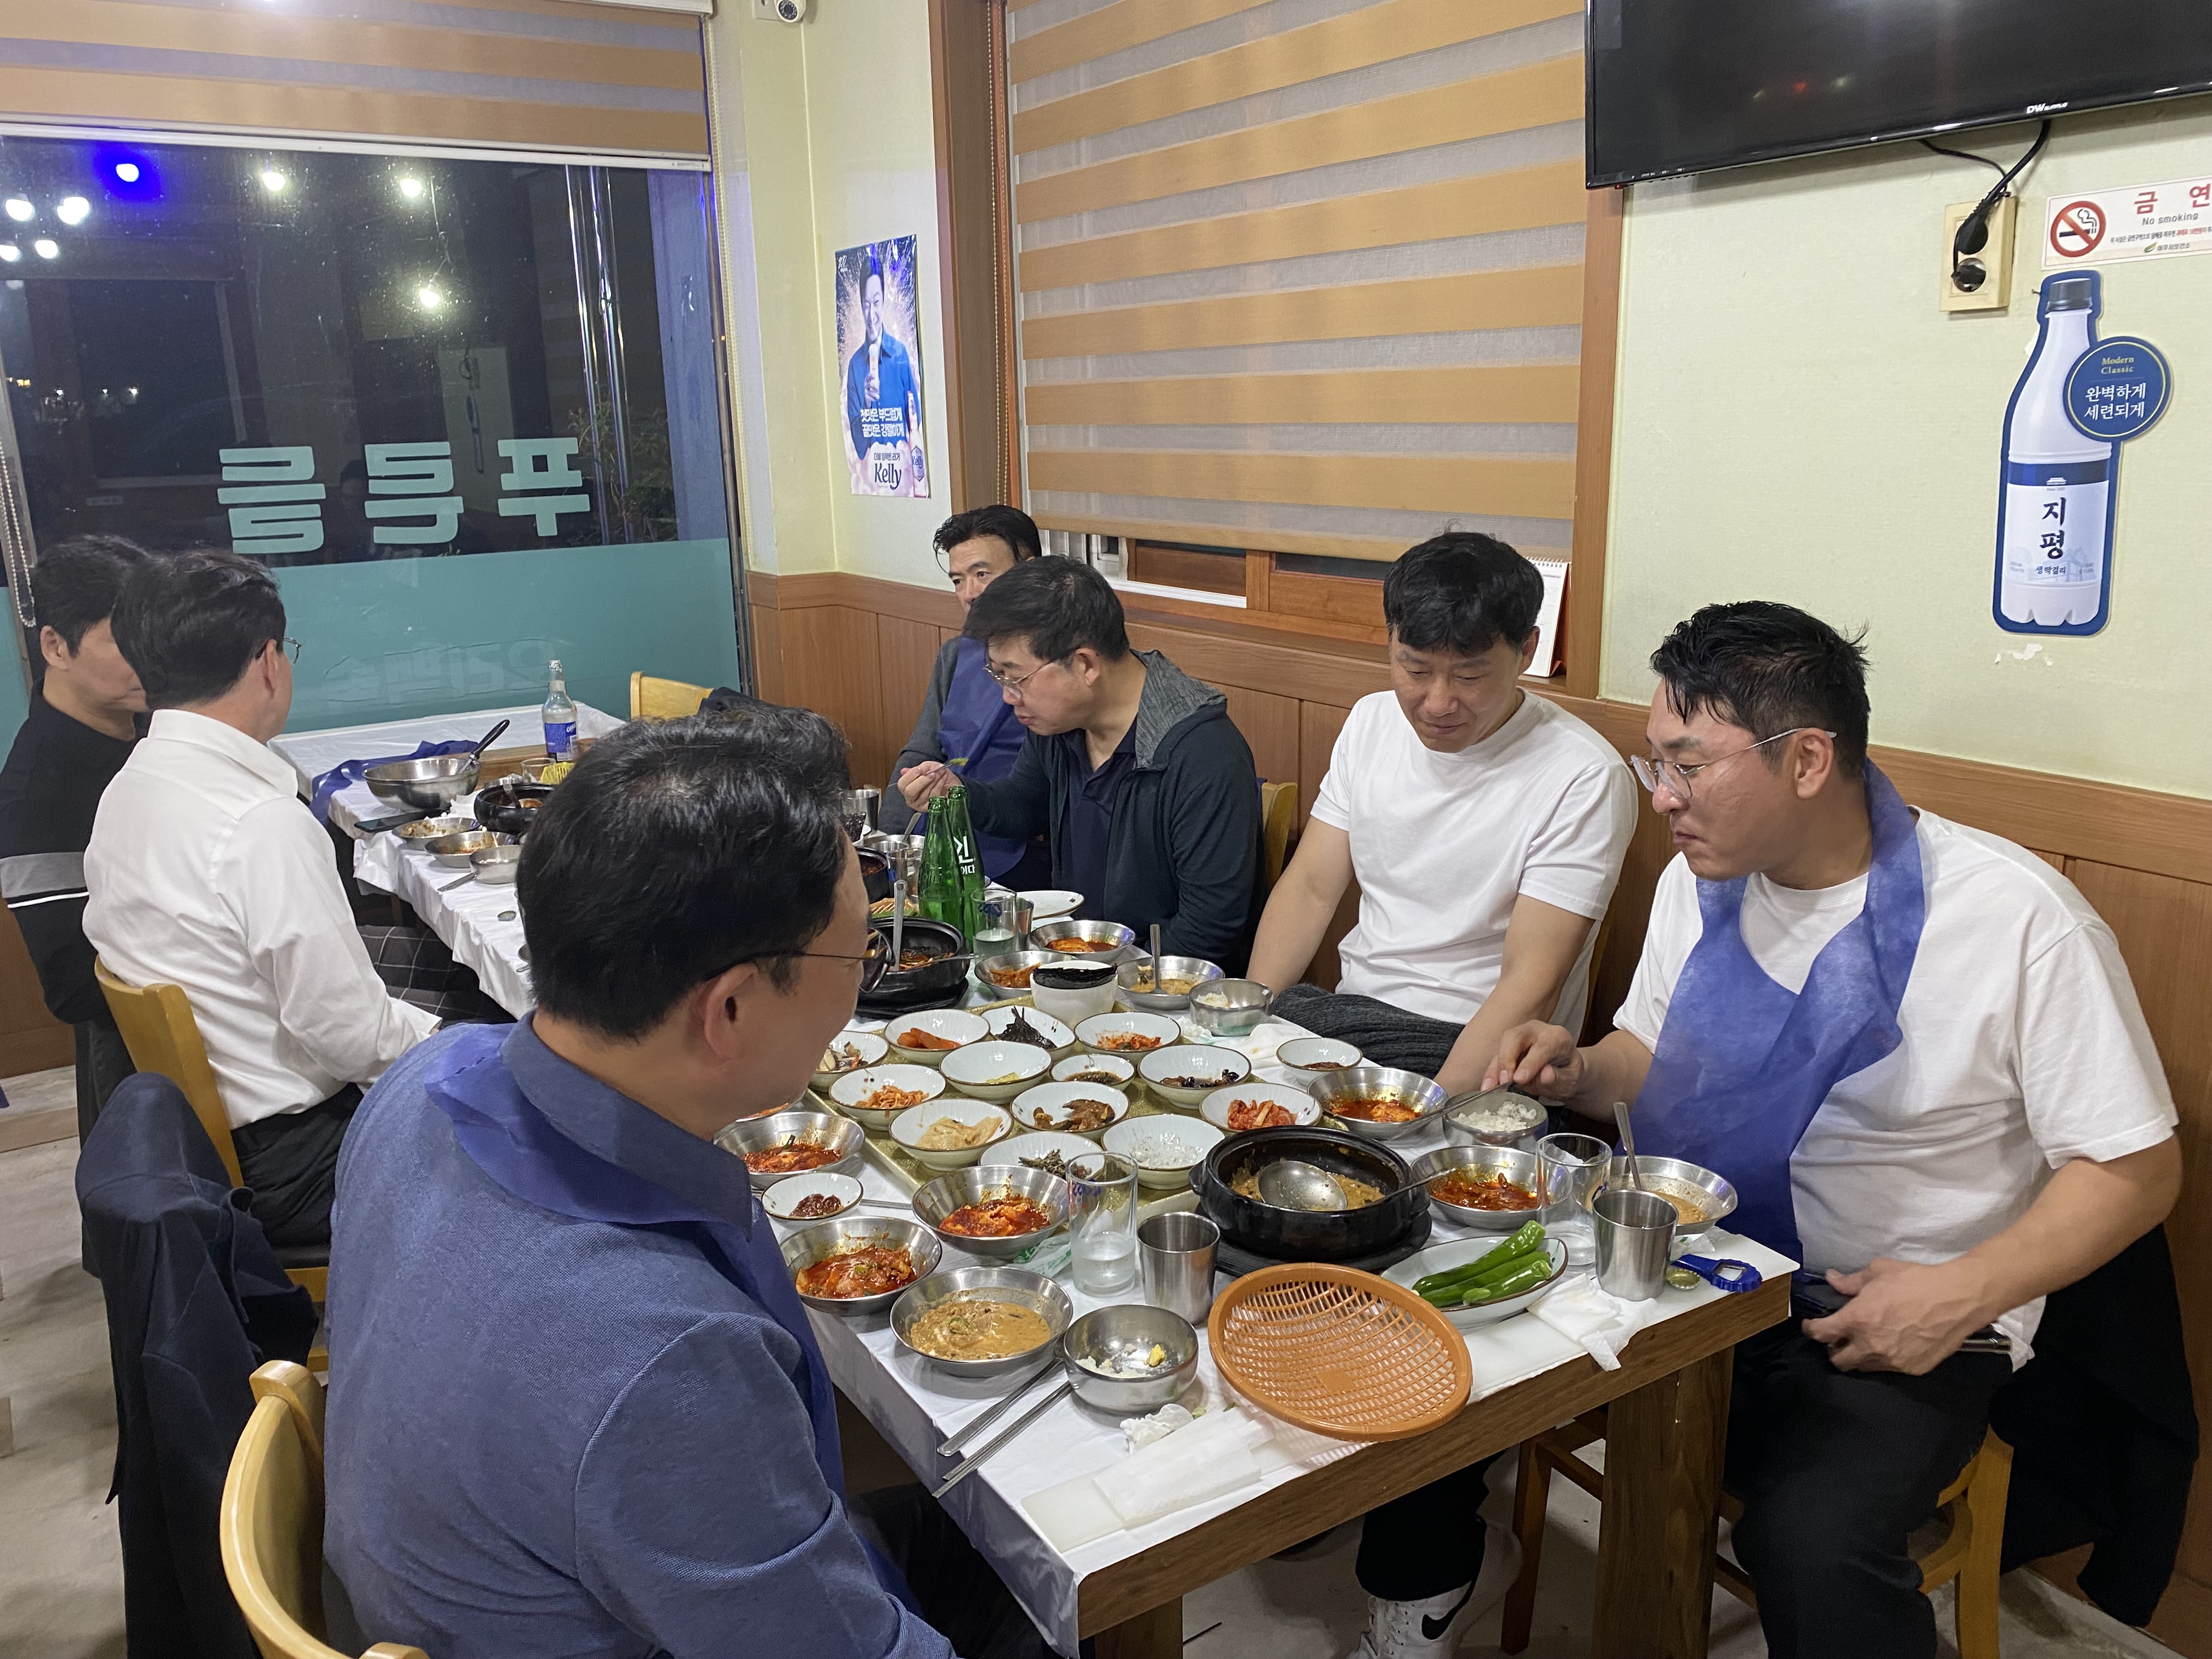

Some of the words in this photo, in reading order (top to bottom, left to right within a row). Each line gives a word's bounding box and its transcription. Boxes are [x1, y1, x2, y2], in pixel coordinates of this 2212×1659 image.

[2142, 217, 2155, 225] No
[2158, 212, 2198, 224] smoking
[2102, 356, 2134, 365] Modern
[2101, 365, 2134, 375] Classic
[2085, 382, 2146, 402] 완벽하게
[2084, 401, 2145, 420] 세련되게
[912, 456, 923, 469] Kelly
[874, 462, 901, 490] Kelly
[2039, 497, 2067, 559] 지평
[2035, 566, 2067, 575] 생막걸리
